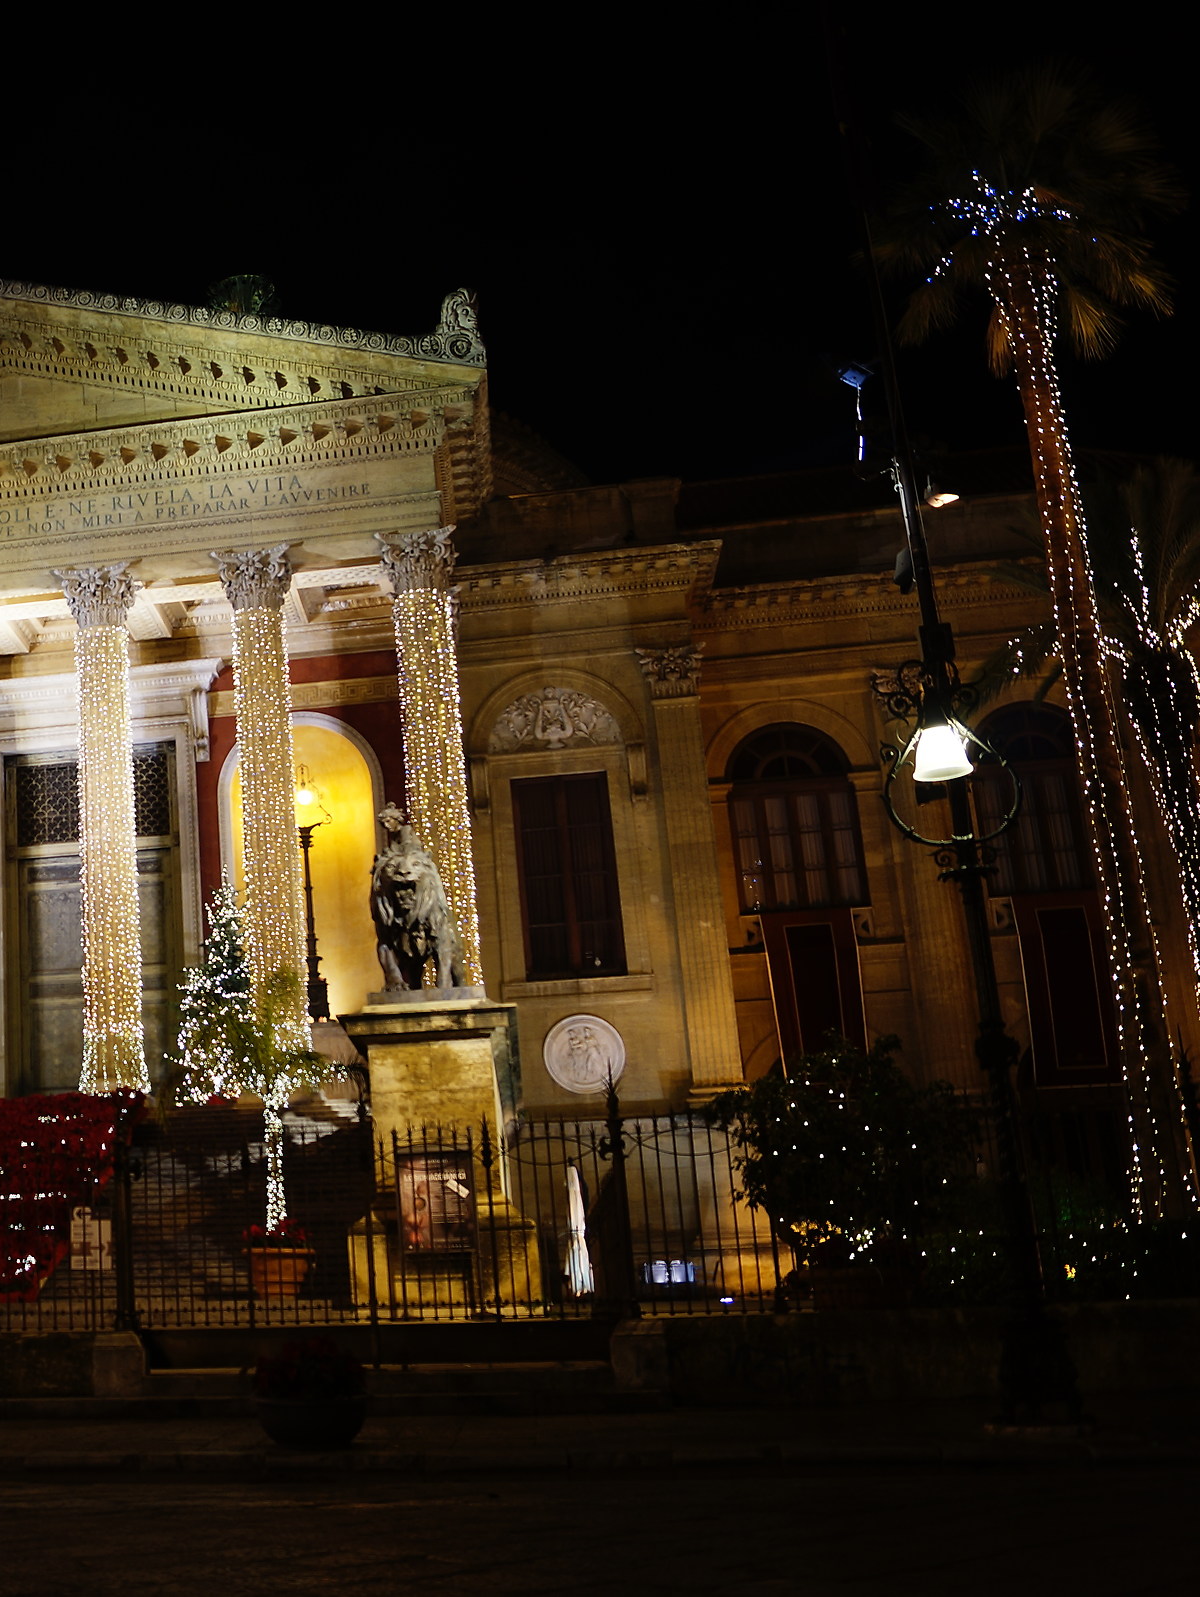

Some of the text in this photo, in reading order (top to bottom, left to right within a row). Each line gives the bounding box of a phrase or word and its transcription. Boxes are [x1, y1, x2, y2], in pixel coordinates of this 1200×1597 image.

[28, 520, 65, 535] NON
[82, 513, 123, 528] MIRI
[134, 511, 144, 522] A
[156, 498, 249, 519] PREPARAR
[45, 504, 55, 519] E
[69, 500, 97, 516] NE
[112, 488, 194, 511] RIVELA
[210, 483, 233, 499] LA
[247, 475, 302, 494] VITA
